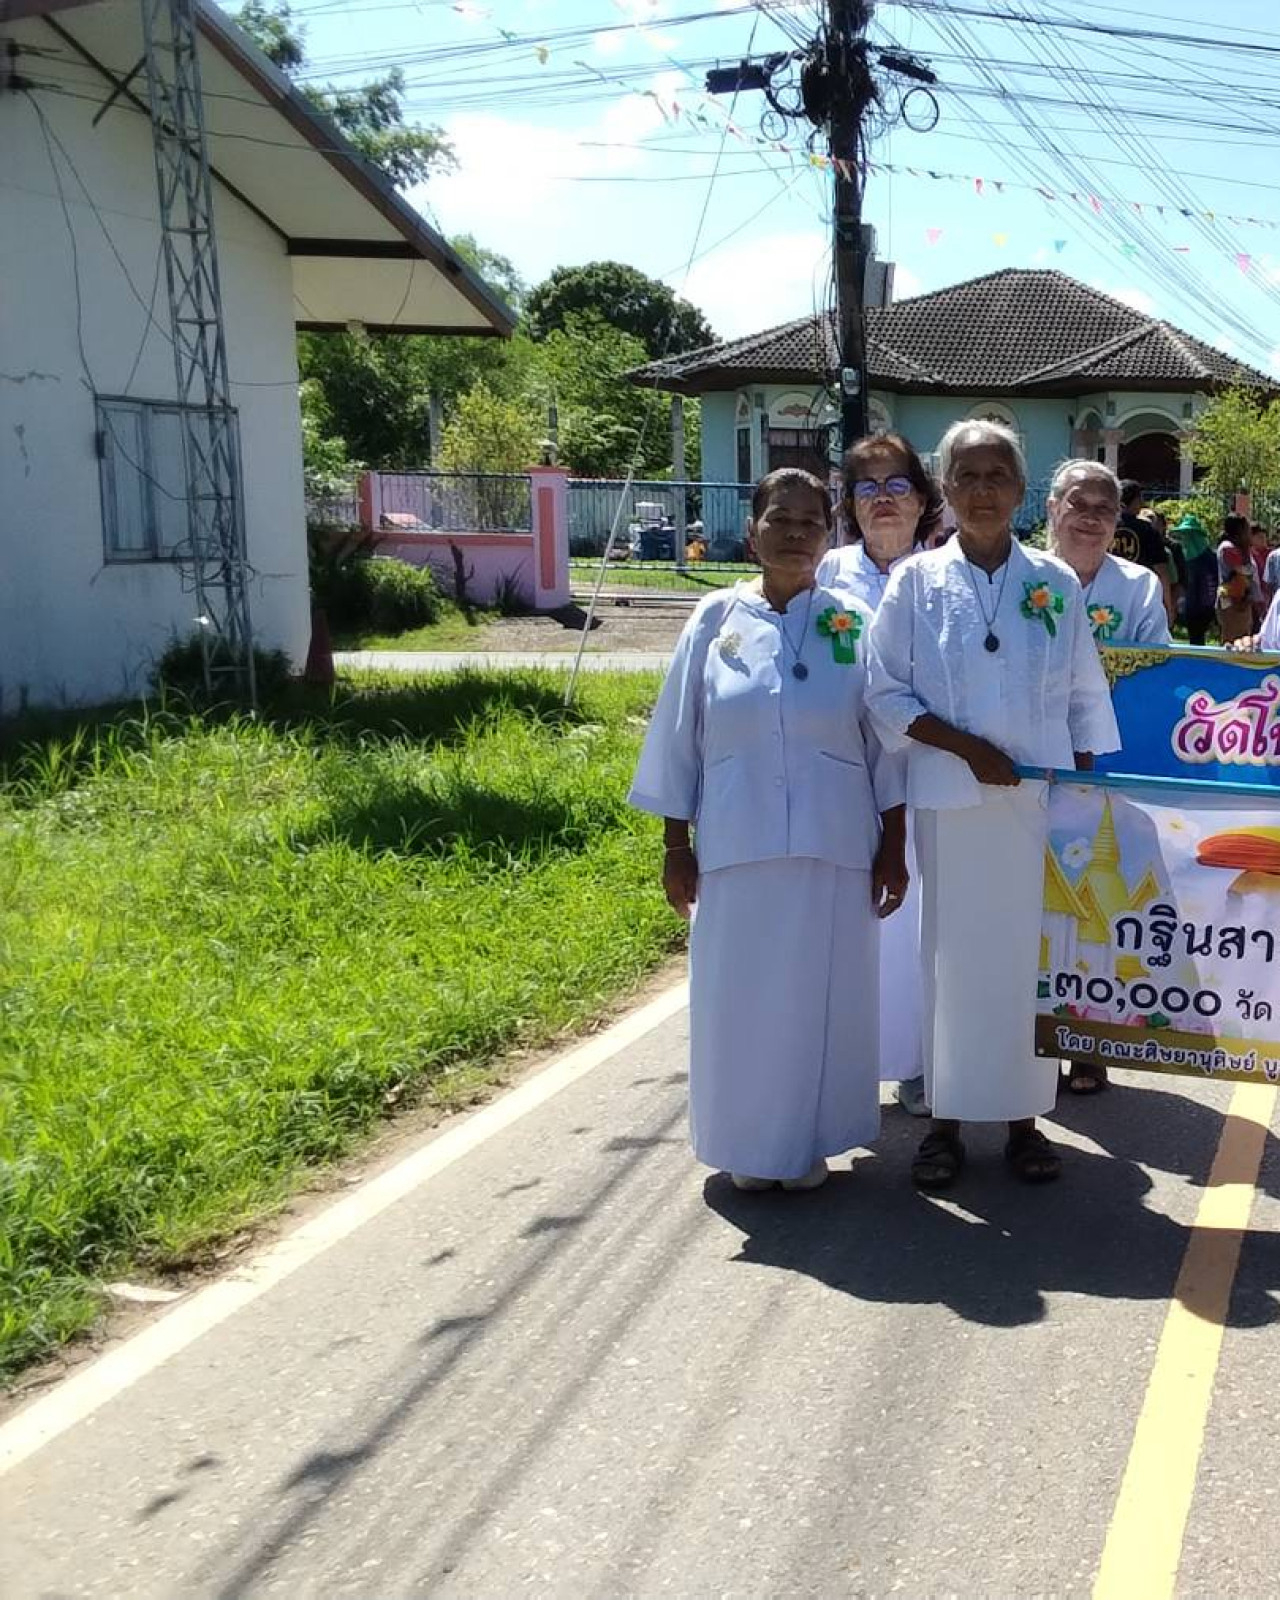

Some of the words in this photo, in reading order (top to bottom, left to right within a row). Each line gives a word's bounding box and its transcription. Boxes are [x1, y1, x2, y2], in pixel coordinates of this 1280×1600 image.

[1055, 972, 1222, 1017] ๓๐,๐๐๐
[1236, 988, 1272, 1022] วัด
[1057, 1028, 1094, 1050] โดย
[1100, 1041, 1255, 1074] คณะศิษยานุศิษย์
